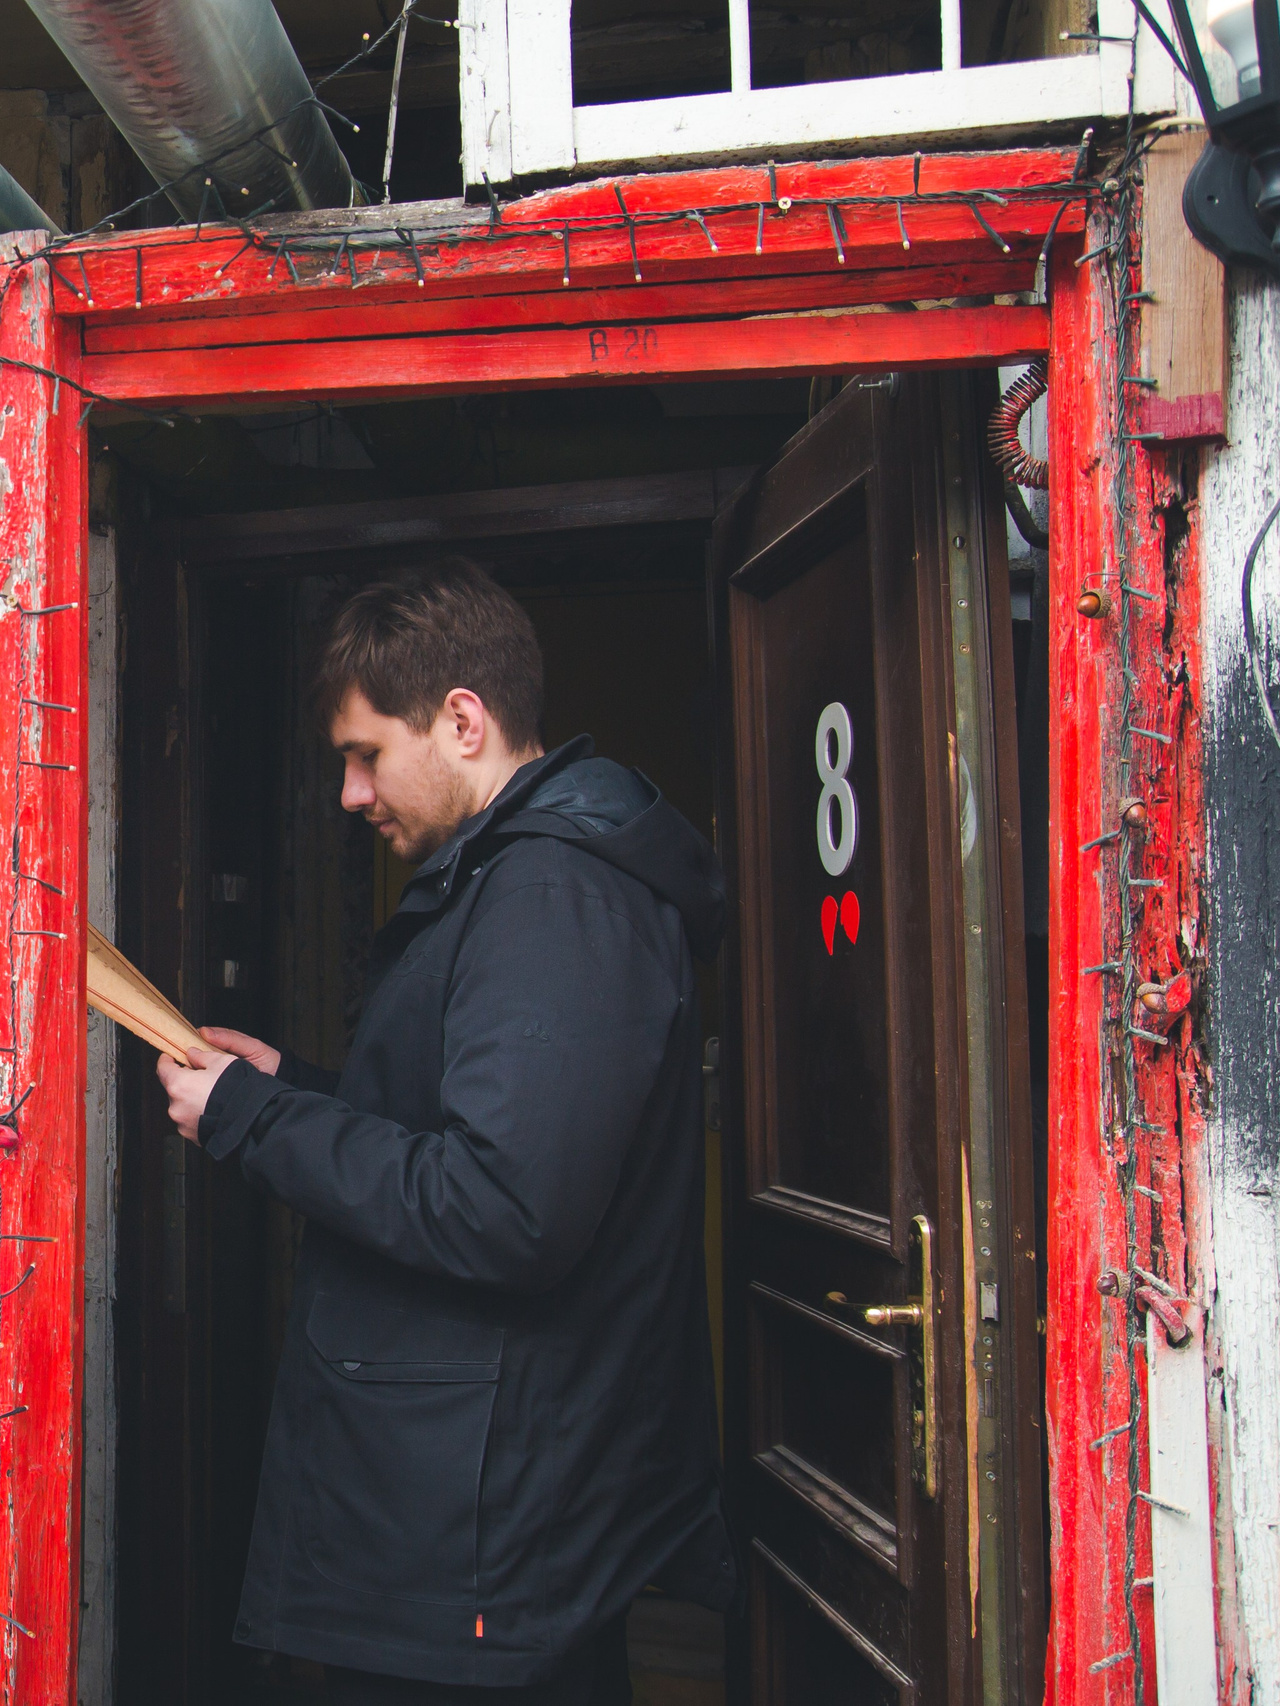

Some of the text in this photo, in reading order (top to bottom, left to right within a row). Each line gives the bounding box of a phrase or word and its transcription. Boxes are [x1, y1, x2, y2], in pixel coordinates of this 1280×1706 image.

[588, 327, 658, 362] B 20
[816, 701, 858, 877] 8
